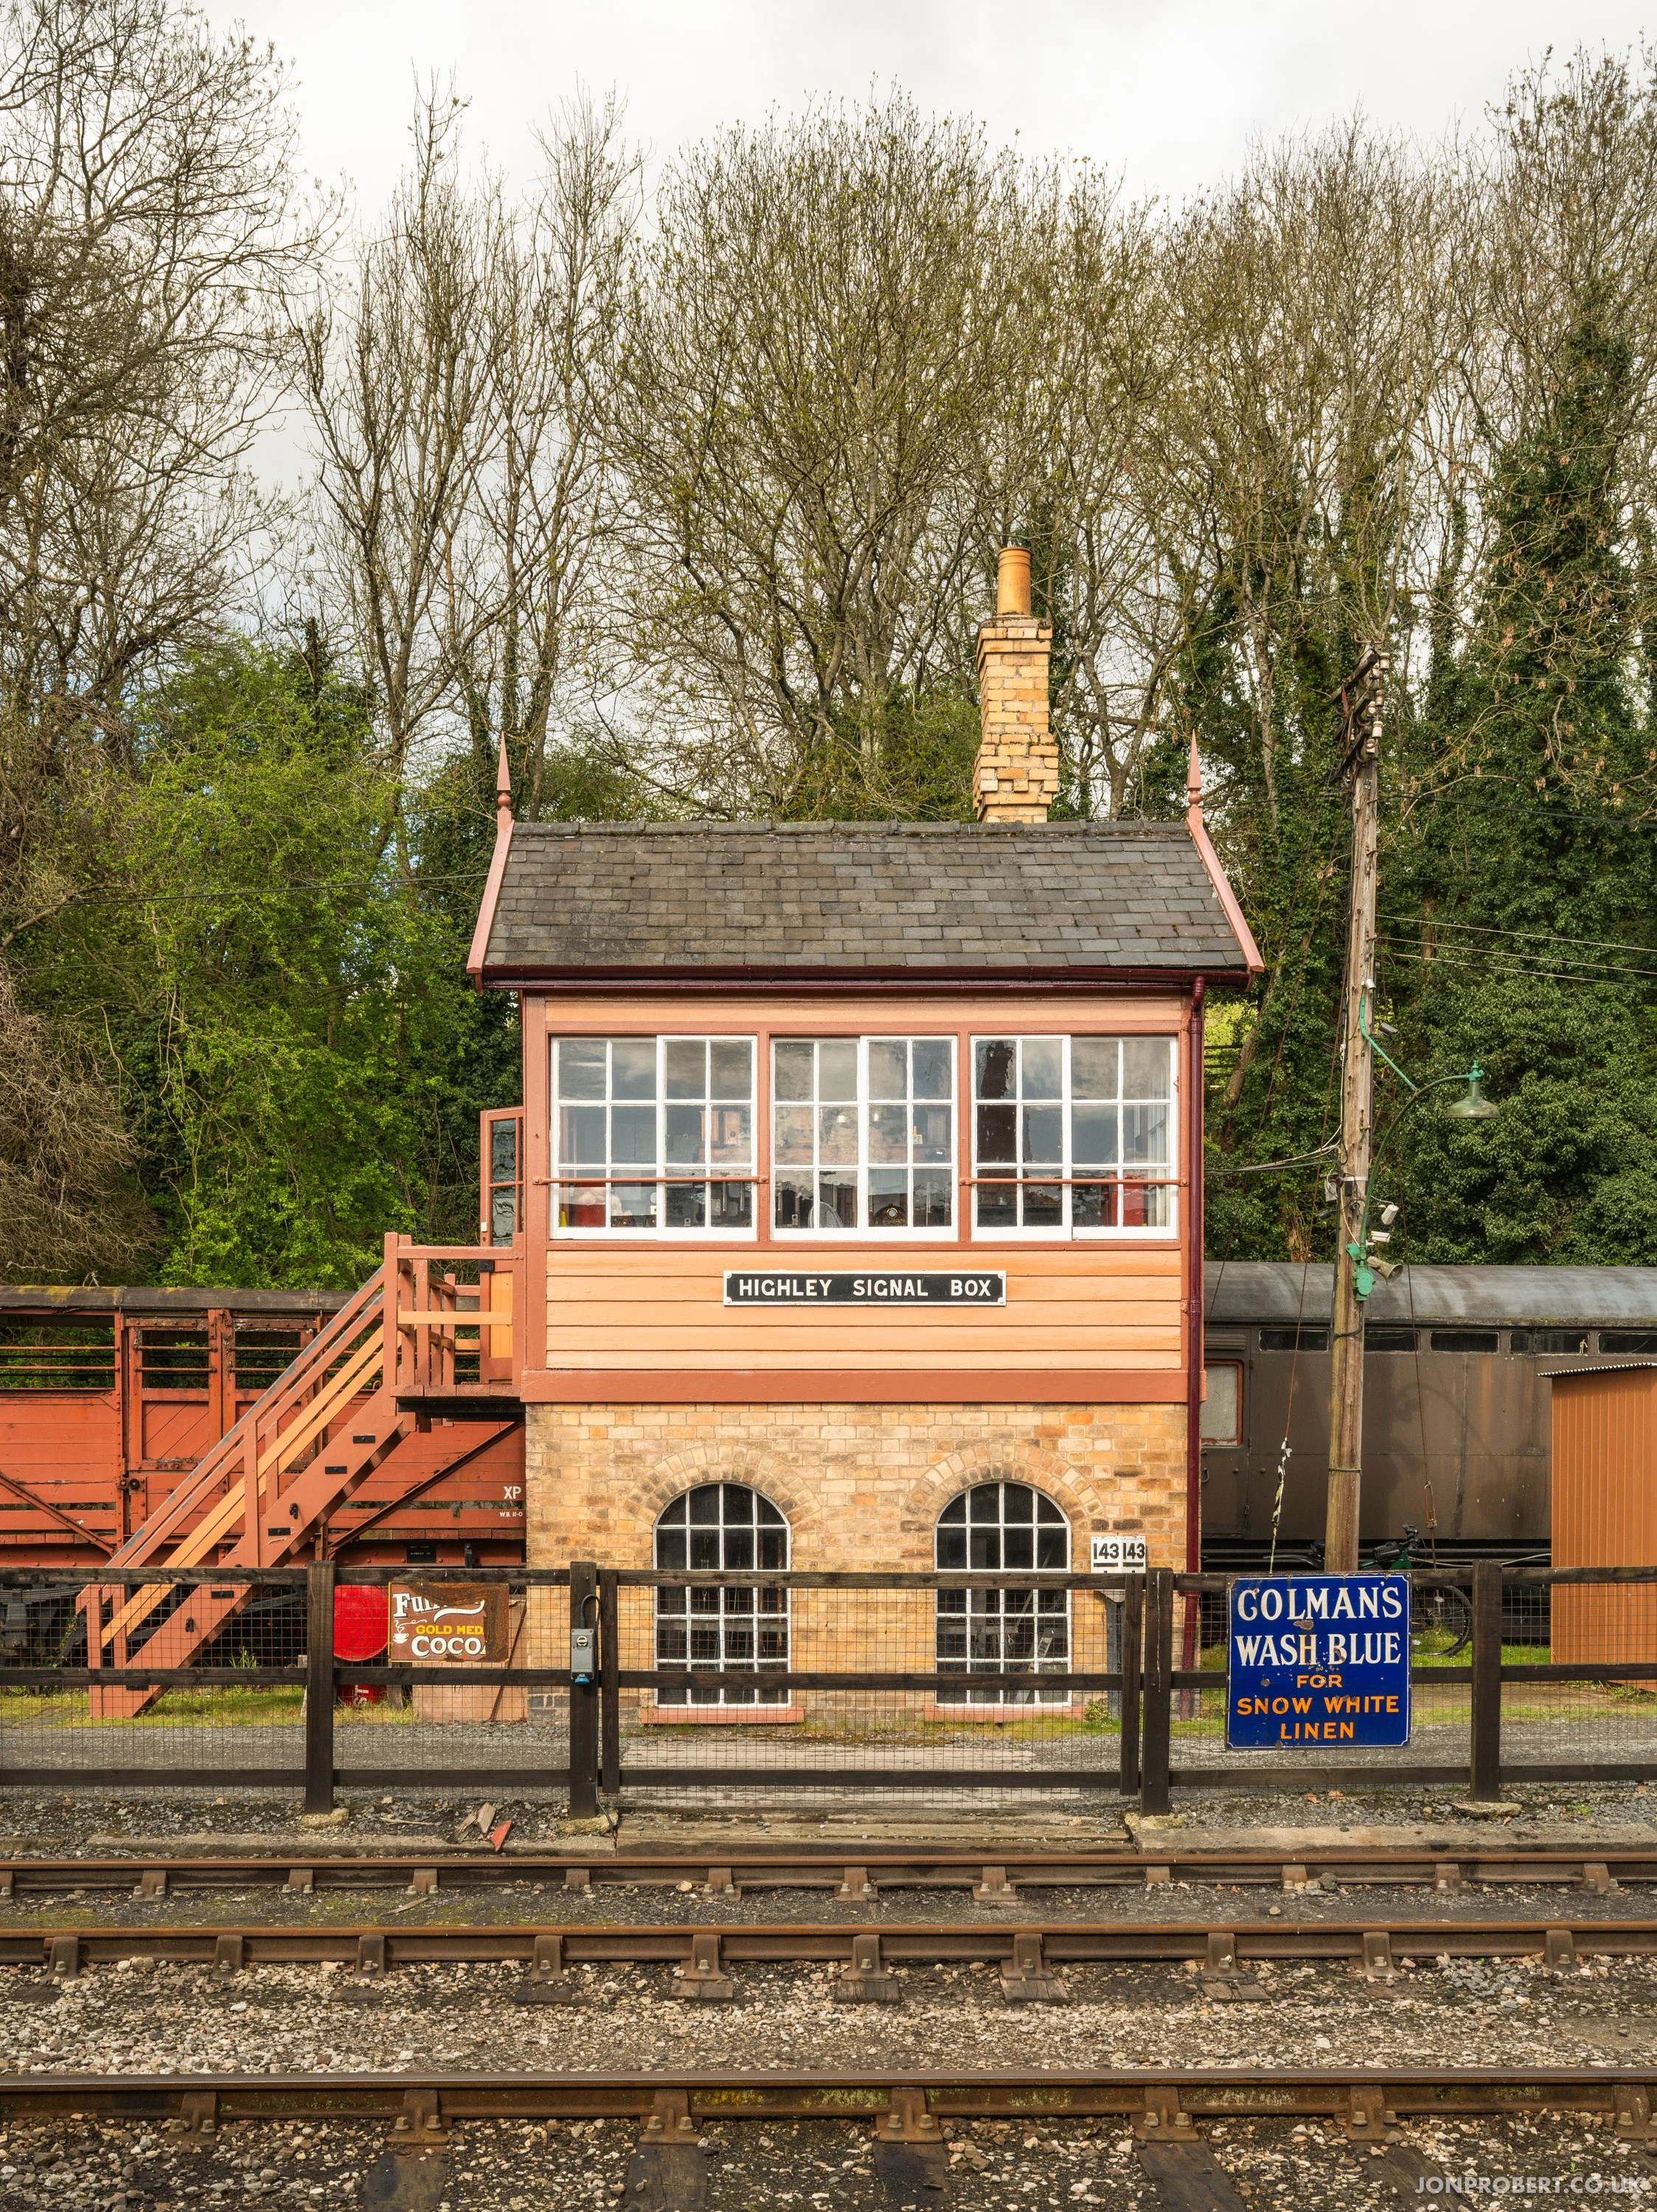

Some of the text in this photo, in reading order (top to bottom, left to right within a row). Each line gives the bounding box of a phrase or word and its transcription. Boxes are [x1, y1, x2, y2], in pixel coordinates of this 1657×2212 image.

[739, 1279, 991, 1296] HIGHLEY SIGNAL BOX
[503, 1486, 522, 1500] XP
[1093, 1543, 1145, 1560] 143 143
[415, 1624, 484, 1635] GOLD MED
[1234, 1632, 1401, 1666] WASH BLUE
[1296, 1674, 1343, 1688] FOR
[1236, 1695, 1400, 1716] SNOW WHITE
[1279, 1722, 1355, 1740] LINEN
